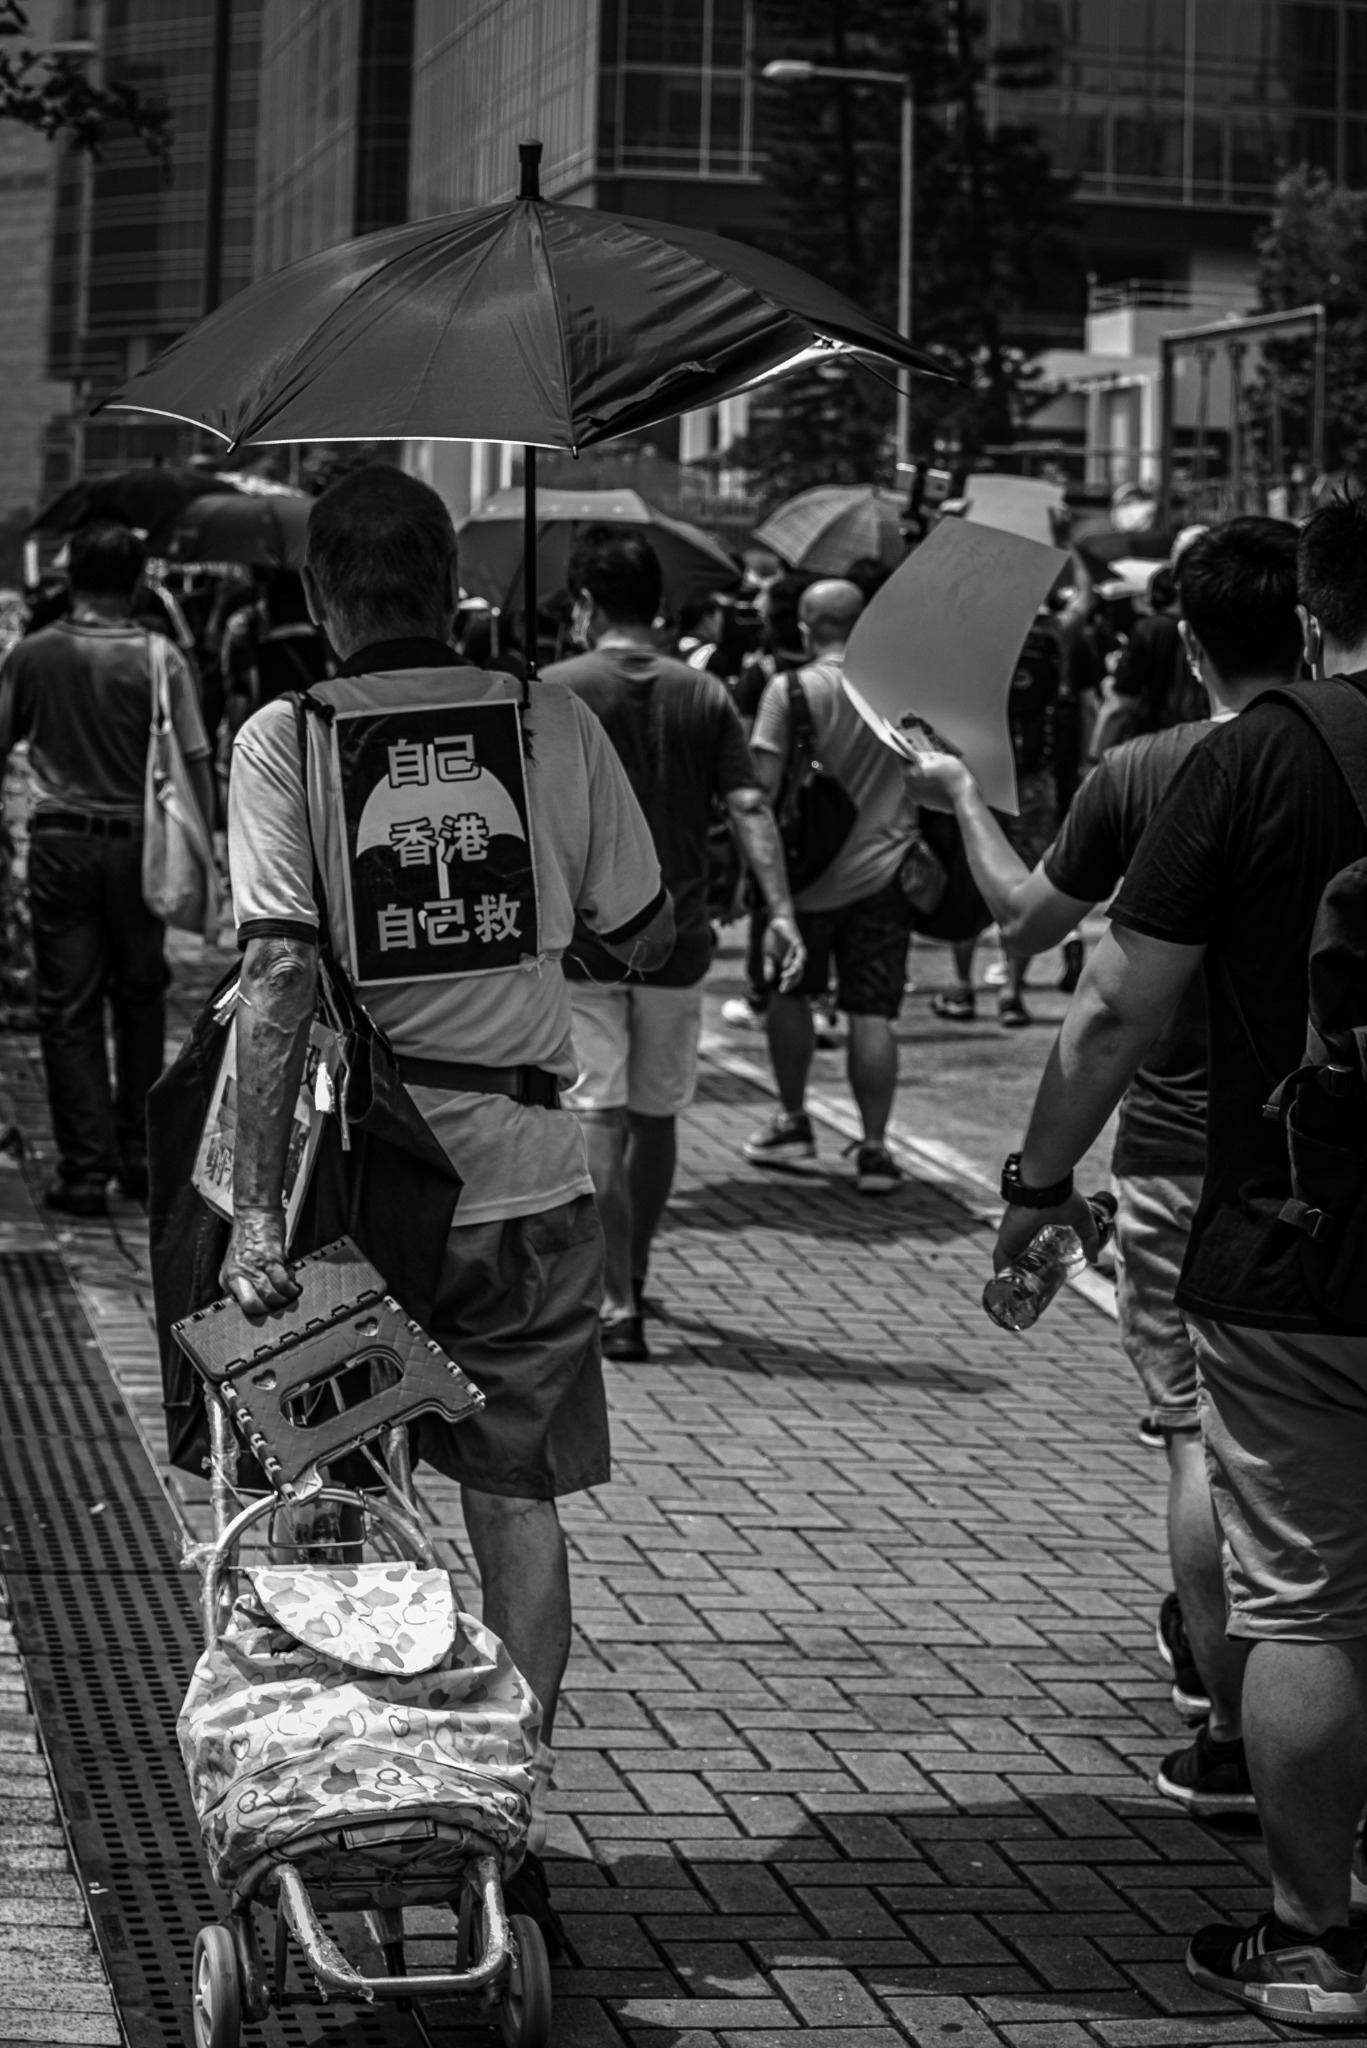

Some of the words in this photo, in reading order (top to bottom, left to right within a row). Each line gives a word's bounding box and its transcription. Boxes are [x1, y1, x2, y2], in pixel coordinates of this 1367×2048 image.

[387, 734, 481, 788] 自己
[389, 813, 489, 867] 香港
[377, 893, 522, 951] 自己救
